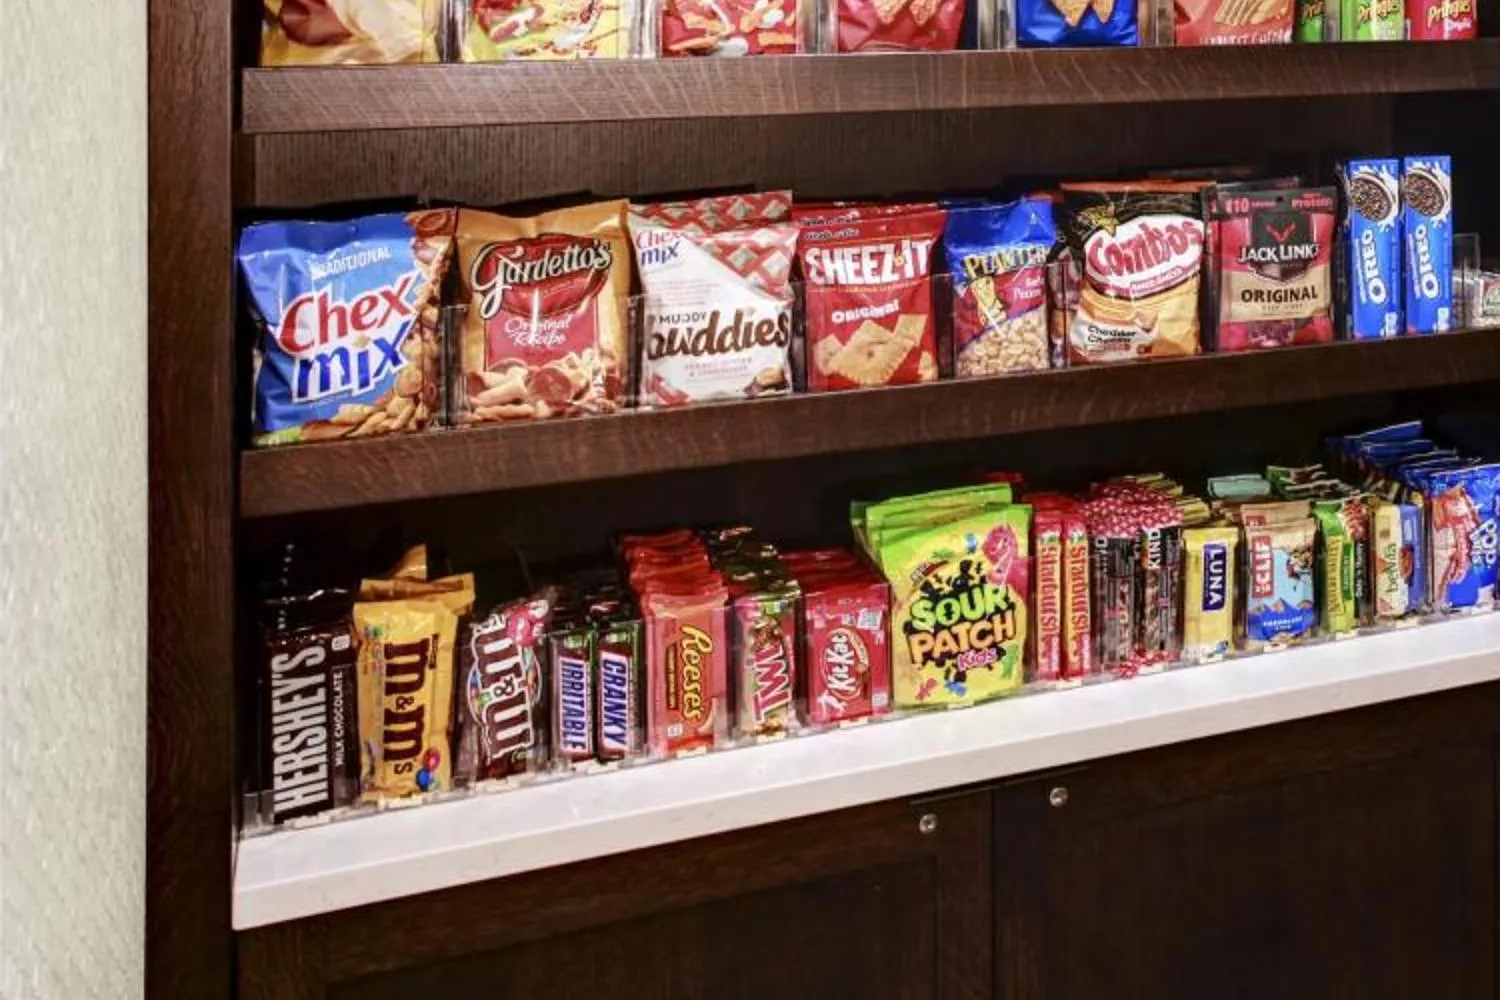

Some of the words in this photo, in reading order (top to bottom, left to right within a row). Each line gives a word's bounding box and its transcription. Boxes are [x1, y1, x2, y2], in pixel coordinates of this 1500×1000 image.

[309, 245, 393, 281] TRADITIONAL
[637, 228, 679, 250] Chex
[639, 241, 680, 267] mix
[964, 247, 1048, 279] PLANTER
[1087, 219, 1202, 277] Combos
[1239, 246, 1276, 263] JACK
[1361, 229, 1387, 305] OREO
[1415, 224, 1439, 300] OREO
[471, 240, 611, 320] Gardetto's
[1240, 284, 1318, 303] ORIGINAL
[280, 275, 414, 353] Chex
[503, 316, 574, 336] Original
[647, 311, 790, 361] buddies
[297, 319, 413, 397] mix
[1147, 527, 1161, 570] KIND
[1255, 544, 1272, 586] CLIF
[1207, 550, 1224, 606] LUNA
[910, 583, 1009, 632] SOUR
[908, 609, 1016, 667] PATCH
[602, 658, 627, 745] CRANKY
[679, 623, 713, 724] Reese's
[271, 645, 330, 813] HERSHEY'S
[332, 671, 346, 738] CHOCOLATE
[560, 661, 586, 751] IRRITABLE
[333, 739, 346, 768] MILK
